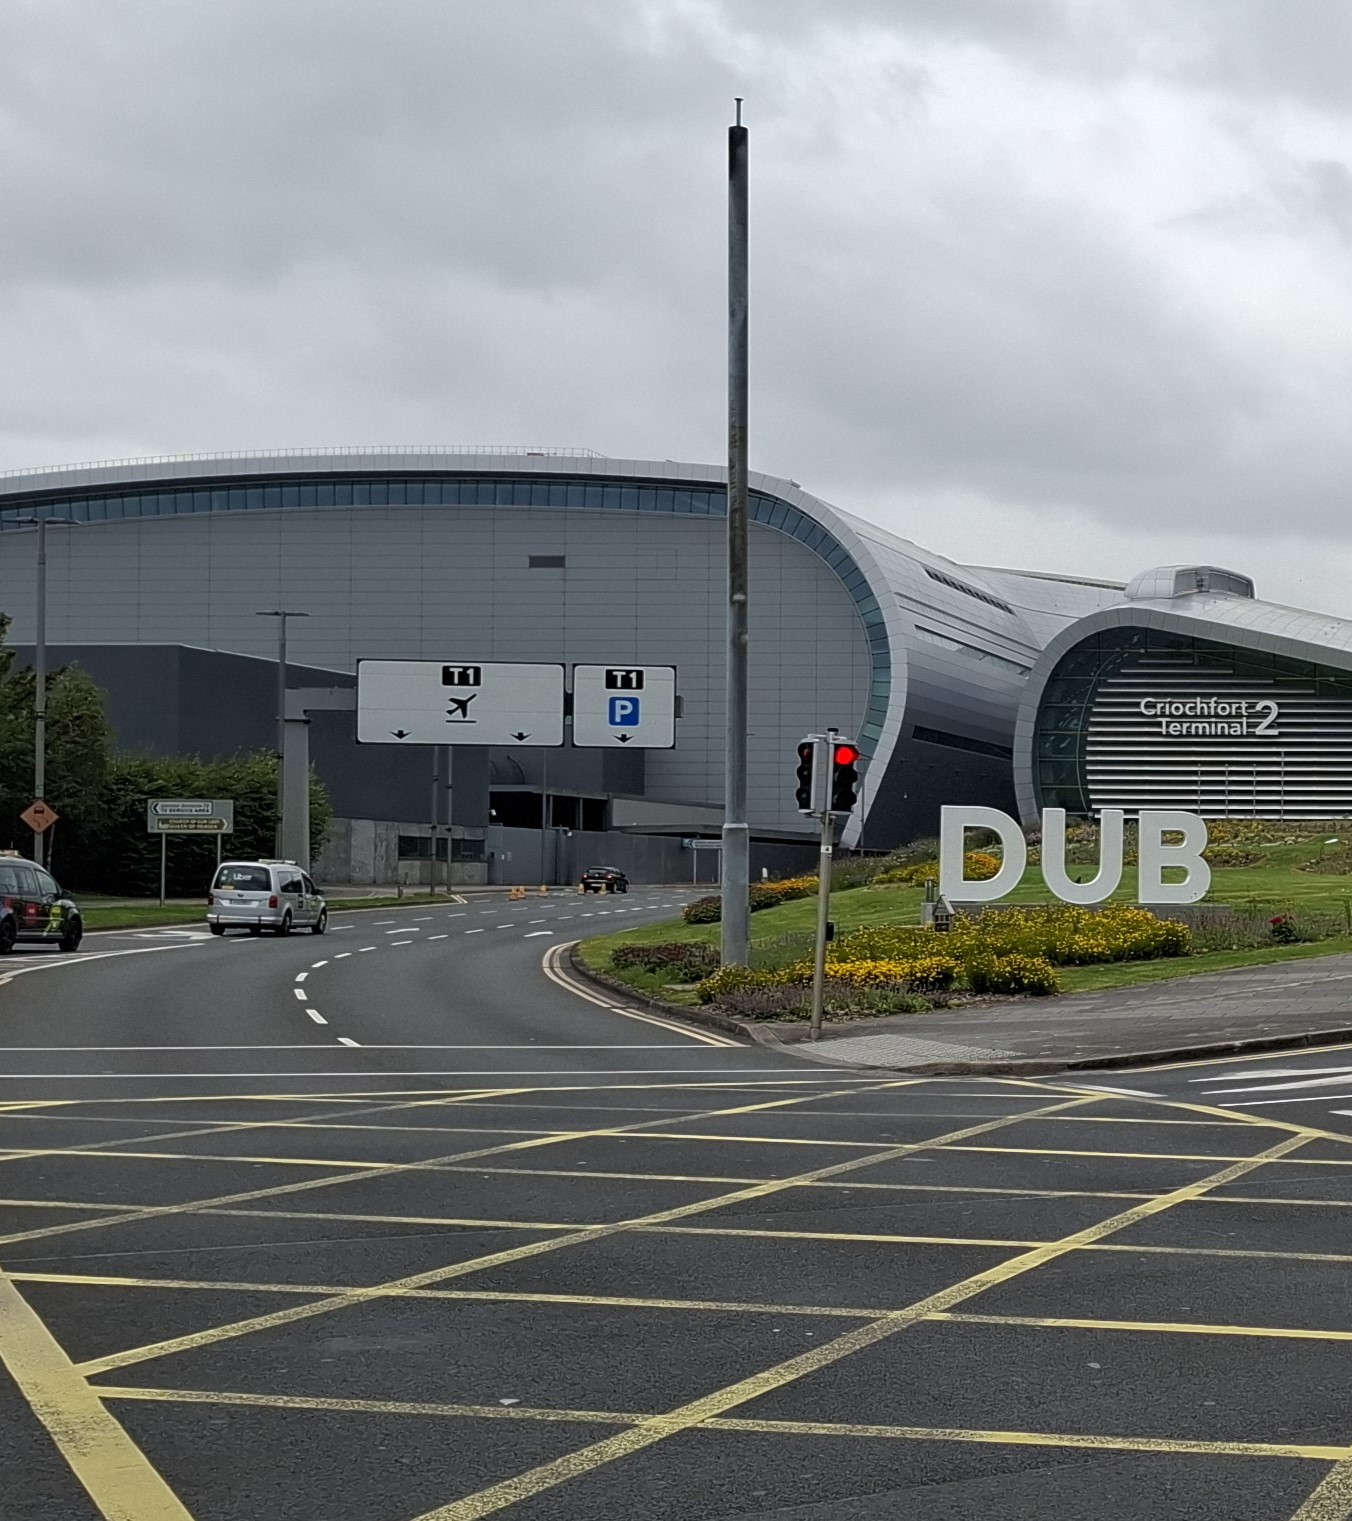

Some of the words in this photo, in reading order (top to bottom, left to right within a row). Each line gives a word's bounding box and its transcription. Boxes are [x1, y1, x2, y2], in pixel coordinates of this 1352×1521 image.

[449, 667, 475, 685] T1
[612, 671, 637, 688] T1
[615, 700, 633, 722] P
[1140, 697, 1249, 716] Críochfort
[1157, 717, 1247, 735] Terminal
[1255, 700, 1279, 735] 2
[939, 804, 1211, 905] DUB
